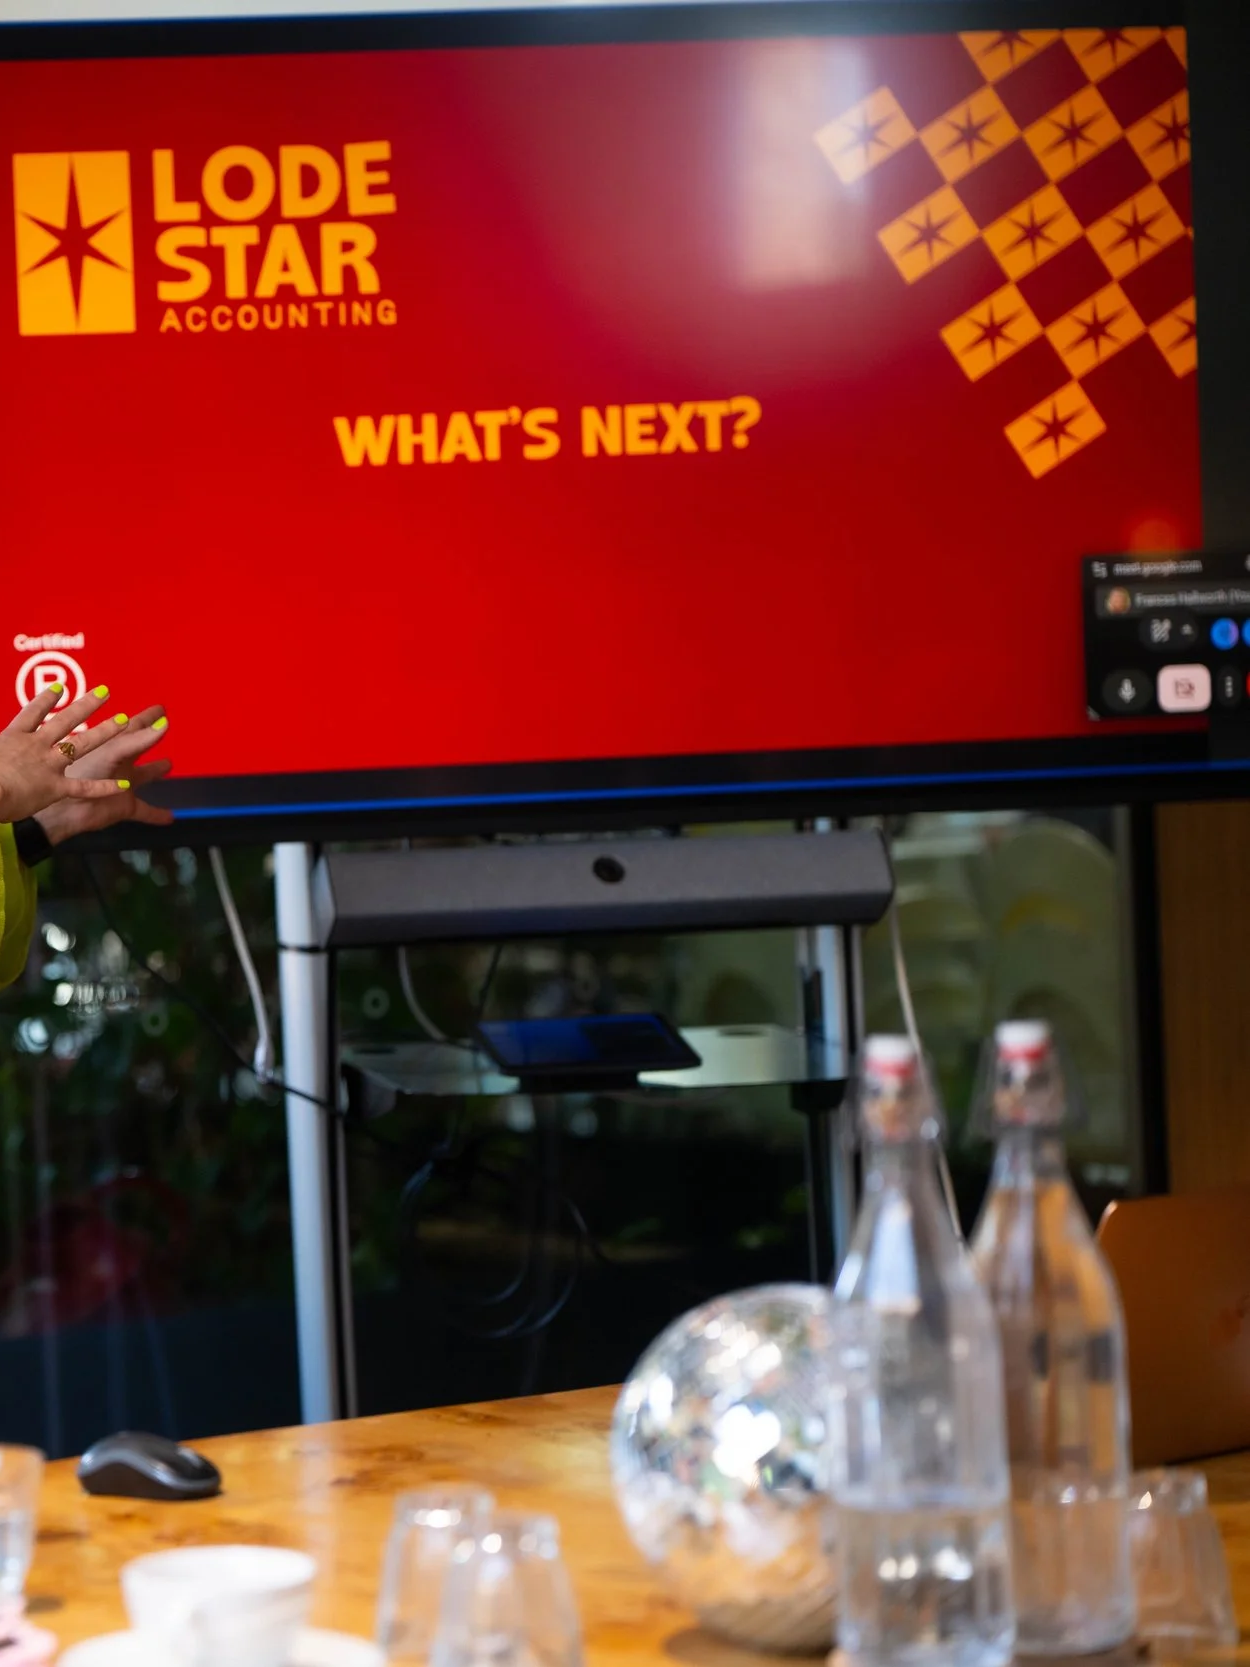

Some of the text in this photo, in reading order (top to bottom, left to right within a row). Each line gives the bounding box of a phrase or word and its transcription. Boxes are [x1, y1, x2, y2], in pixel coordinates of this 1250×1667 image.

[152, 140, 397, 222] LODE
[155, 222, 380, 302] STAR
[159, 299, 397, 333] ACCOUNTING
[333, 395, 762, 467] WHAT'S NEXT?
[13, 632, 84, 652] Certified
